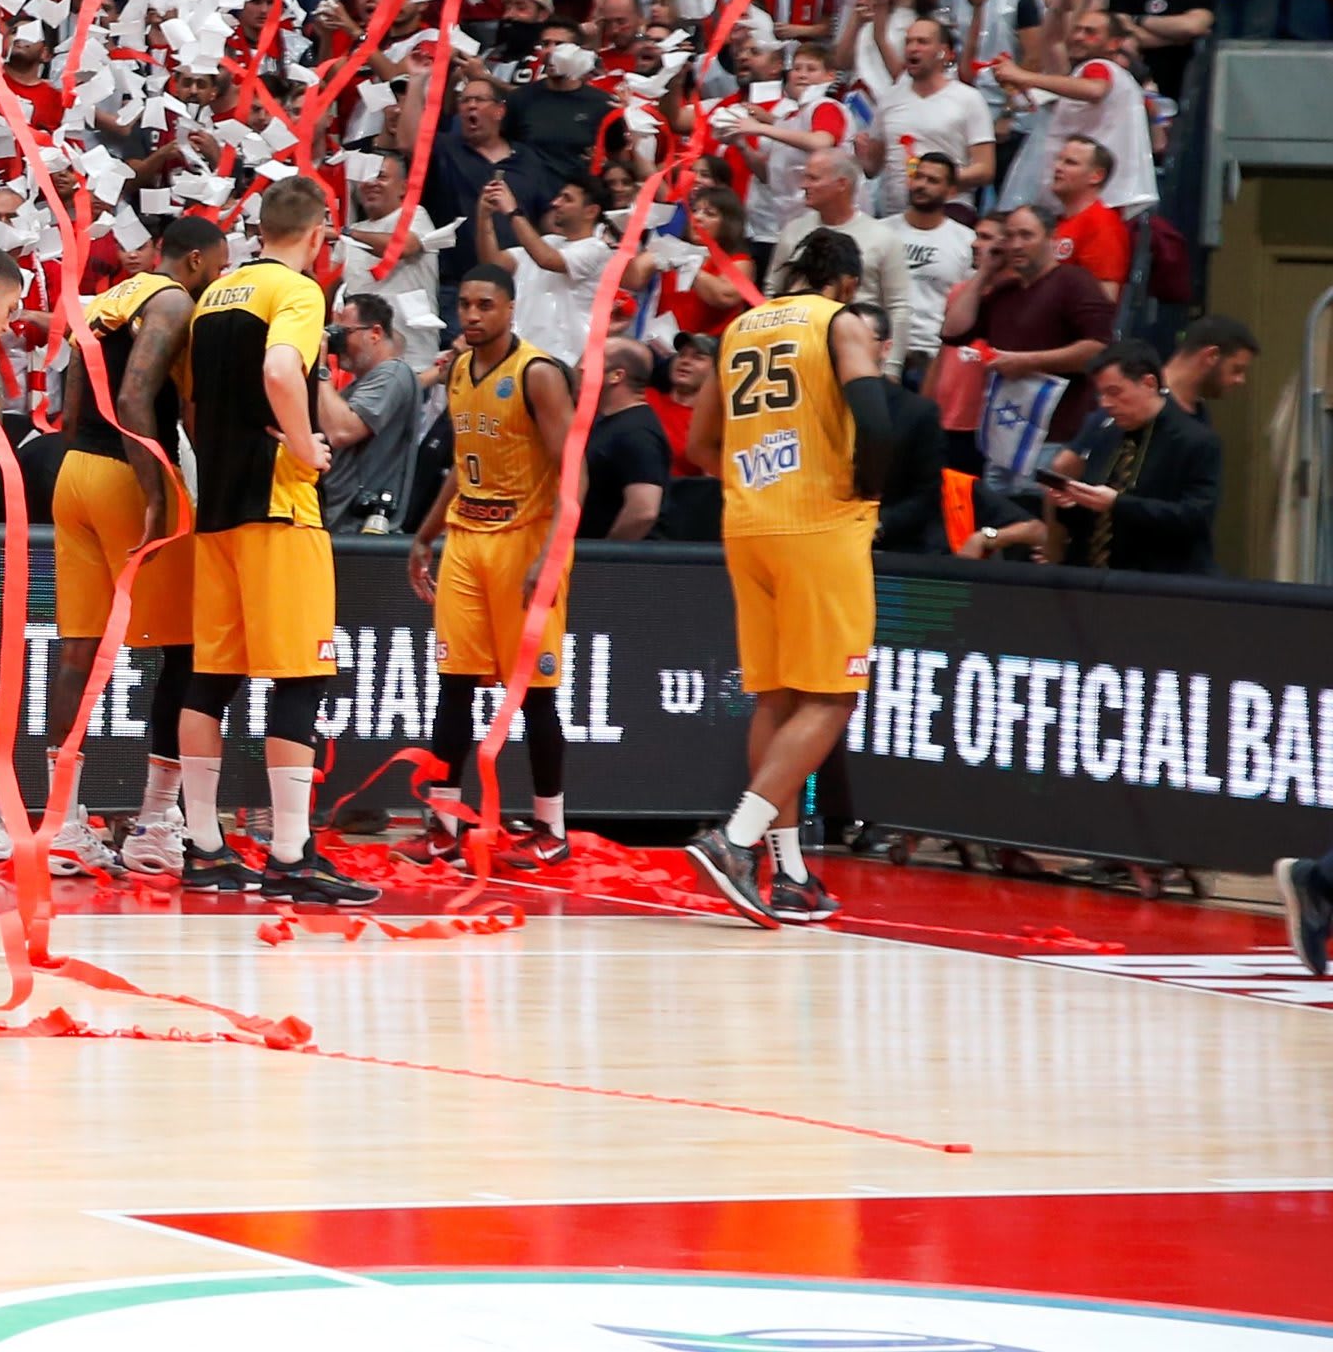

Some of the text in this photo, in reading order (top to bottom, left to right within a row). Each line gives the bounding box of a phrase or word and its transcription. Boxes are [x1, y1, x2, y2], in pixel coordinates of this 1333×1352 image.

[203, 287, 255, 308] MADSEN
[729, 341, 803, 421] 25
[466, 453, 481, 487] 0
[952, 651, 1222, 794] OFFICIAL
